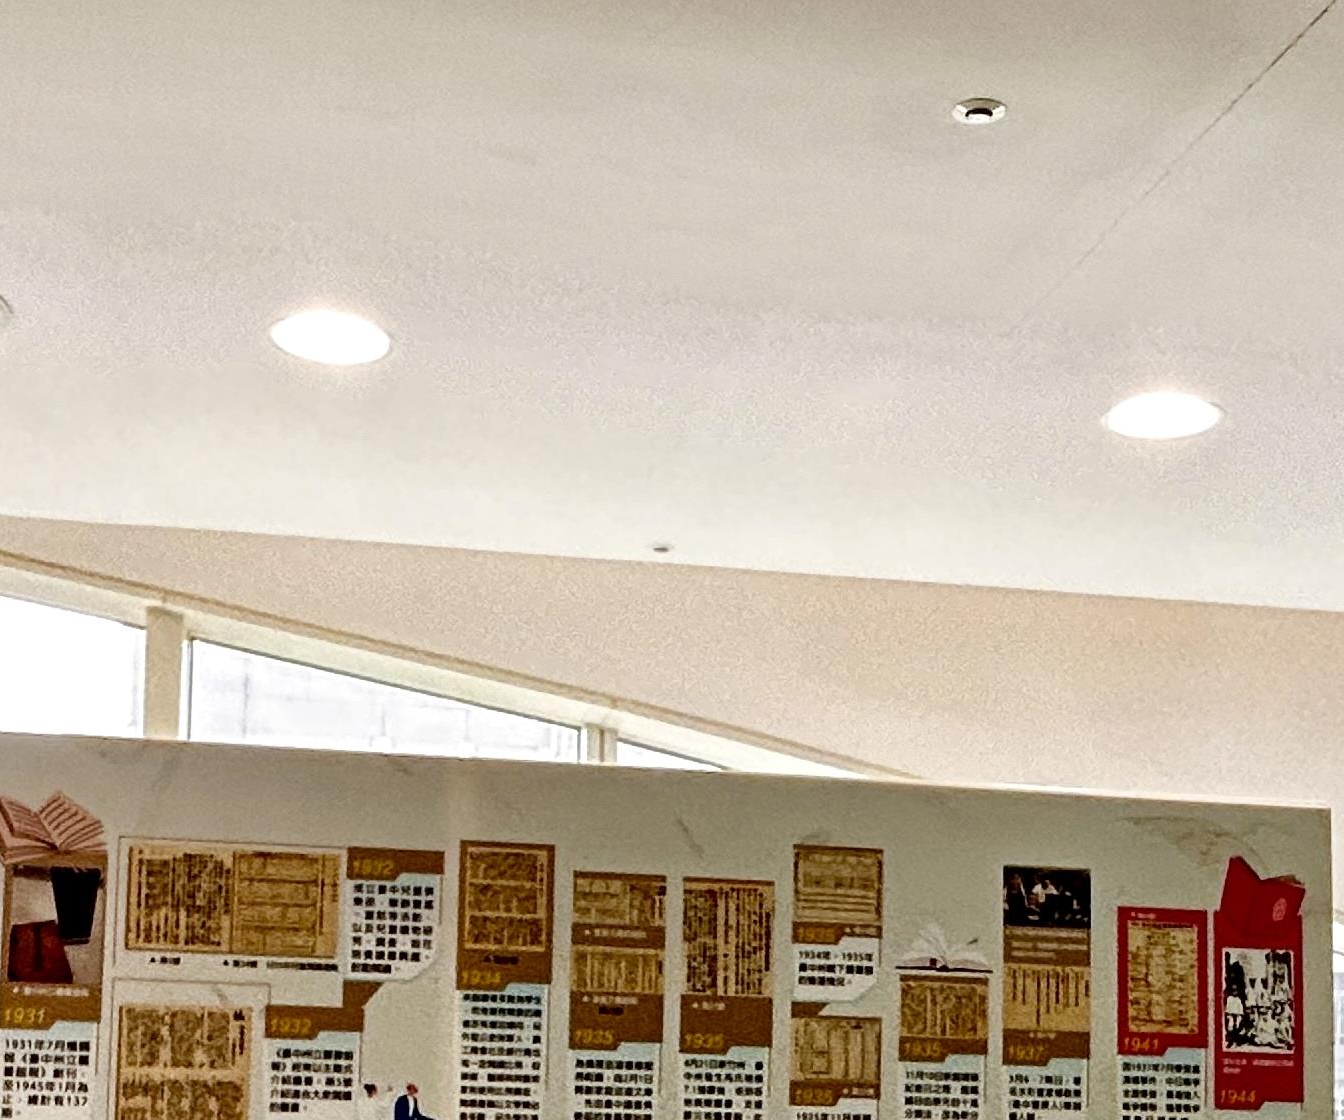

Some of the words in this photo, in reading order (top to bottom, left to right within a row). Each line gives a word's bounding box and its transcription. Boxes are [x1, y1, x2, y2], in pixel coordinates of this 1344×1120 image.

[4, 1008, 46, 1024] 1931
[1123, 1038, 1159, 1051] 1941
[1220, 1089, 1257, 1104] 1944
